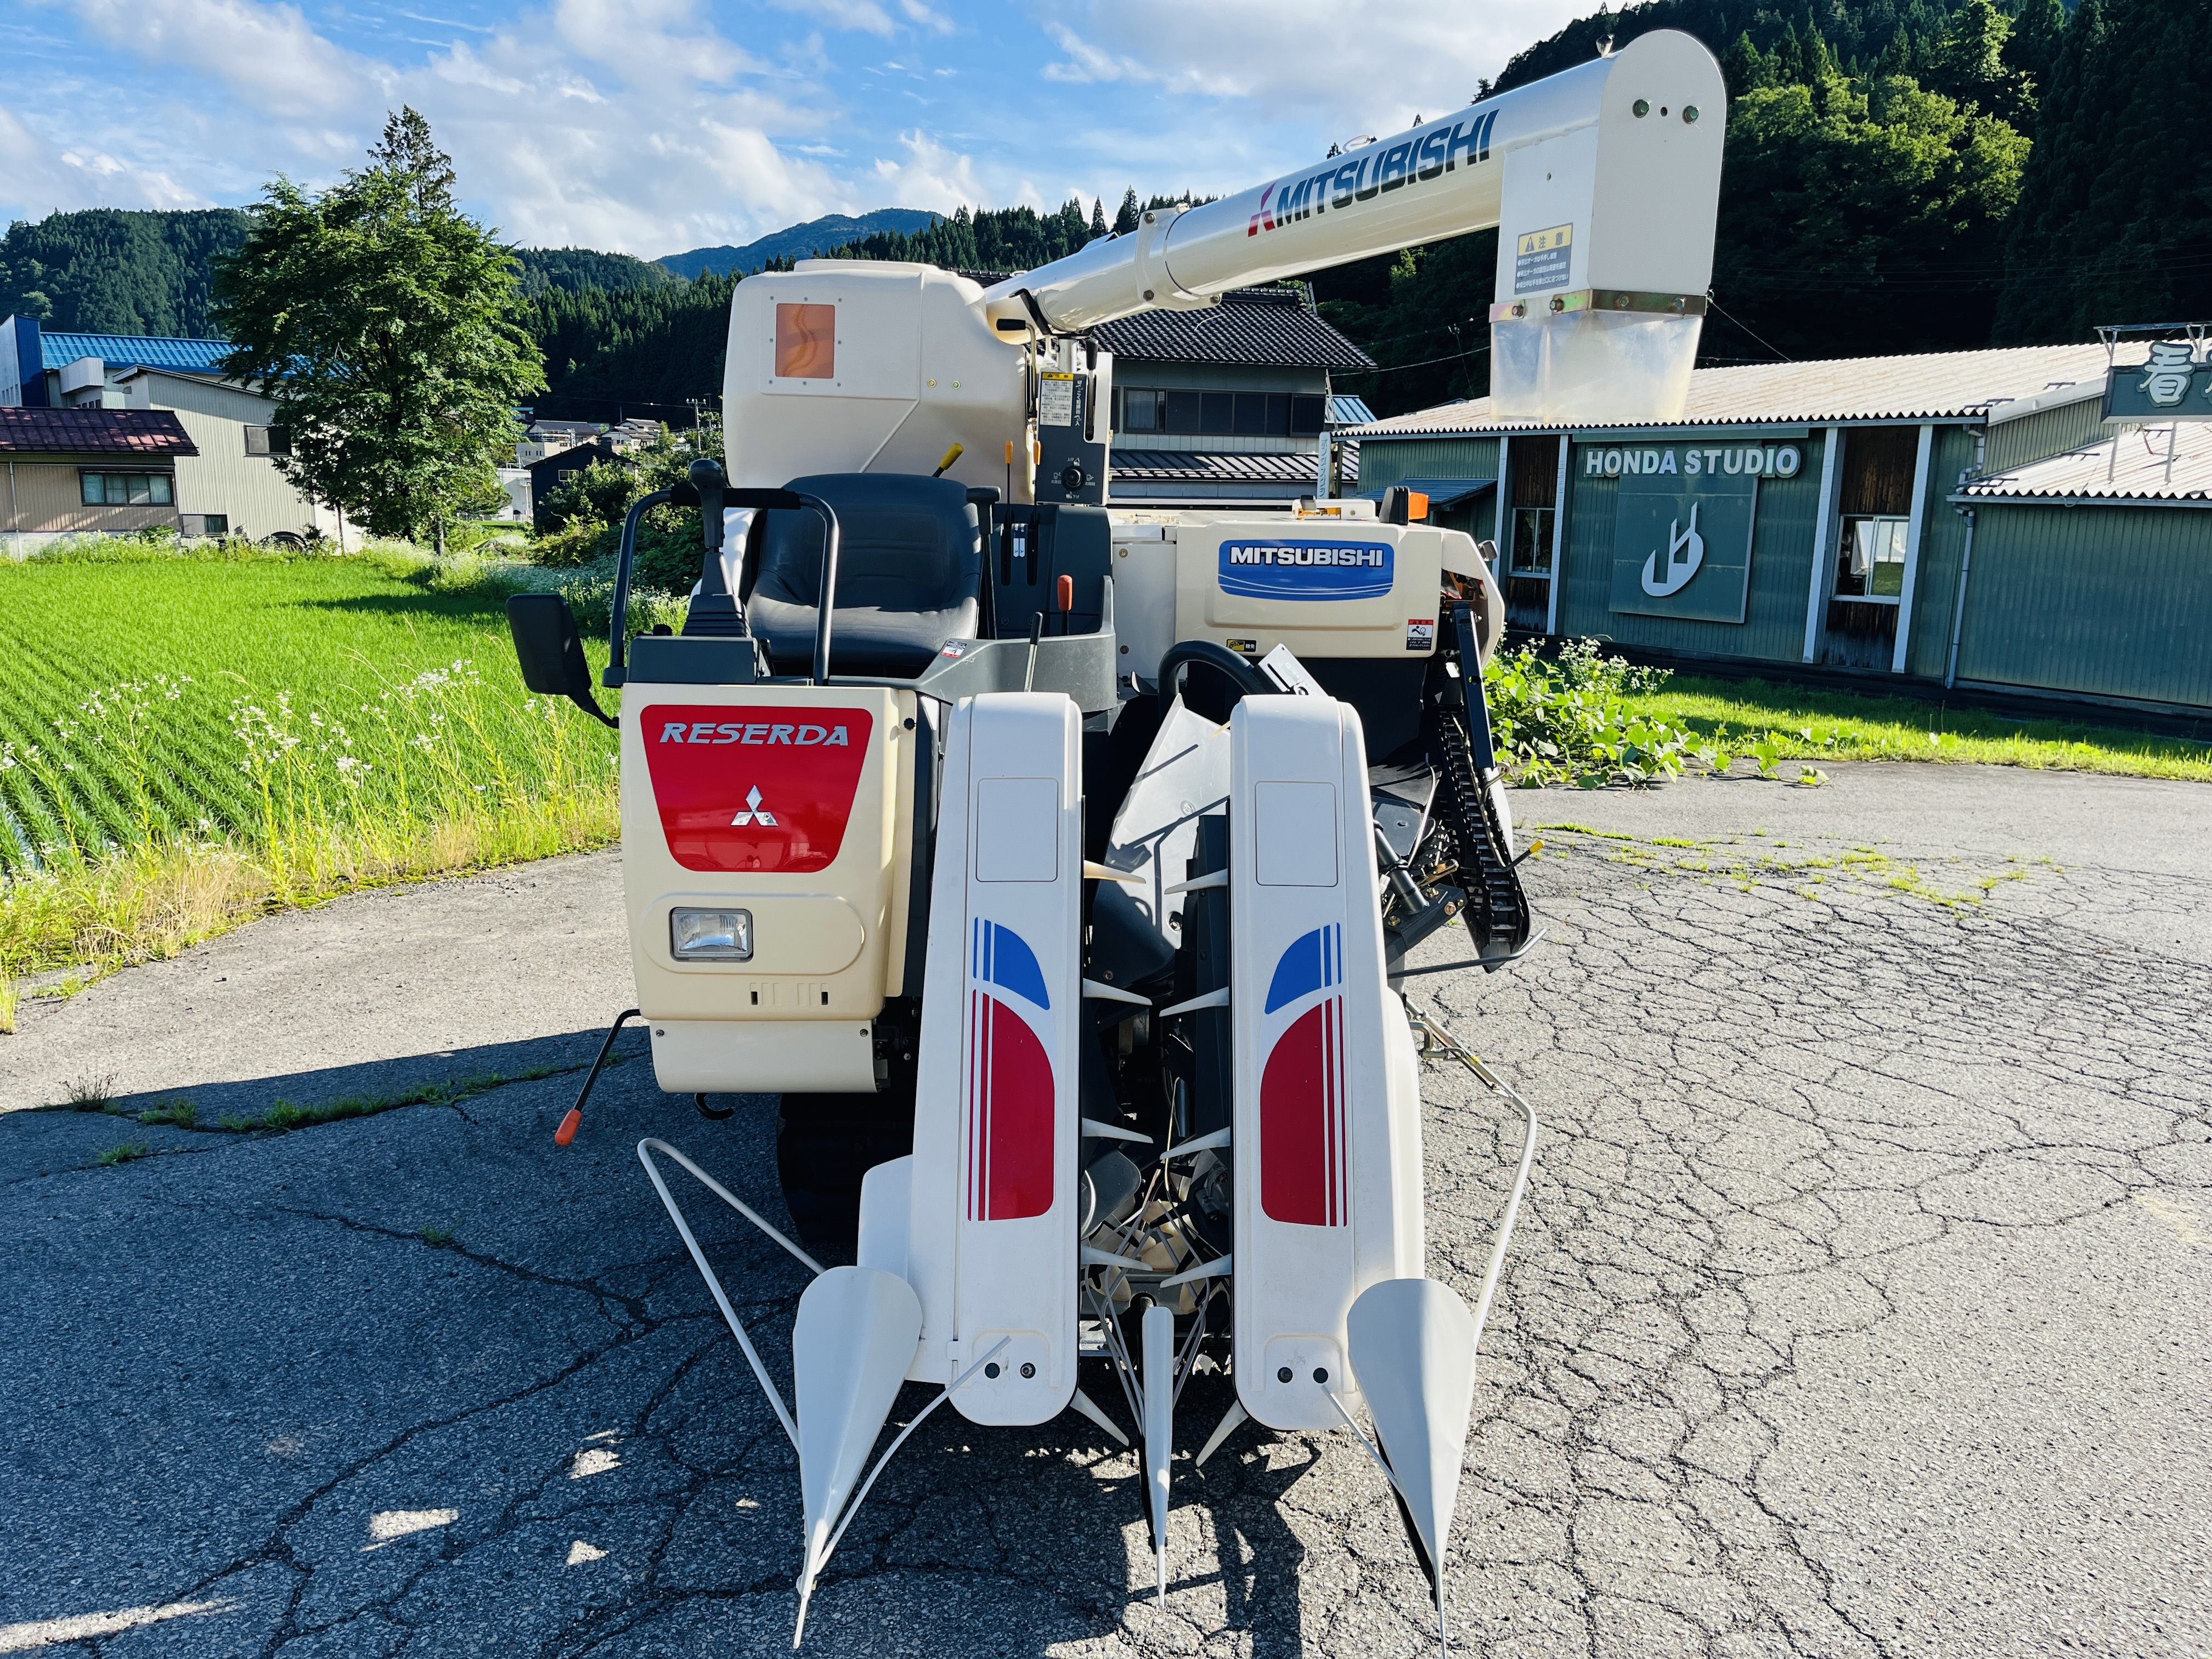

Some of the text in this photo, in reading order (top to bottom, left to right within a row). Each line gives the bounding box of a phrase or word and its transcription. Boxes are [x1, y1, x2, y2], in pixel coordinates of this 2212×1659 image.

[1277, 109, 1500, 228] MITSUBISHI
[2139, 344, 2212, 404] 看
[1585, 448, 1798, 475] HONDA STUDIO
[1230, 546, 1384, 567] MITSUBISHI
[659, 723, 848, 746] RESERDA
